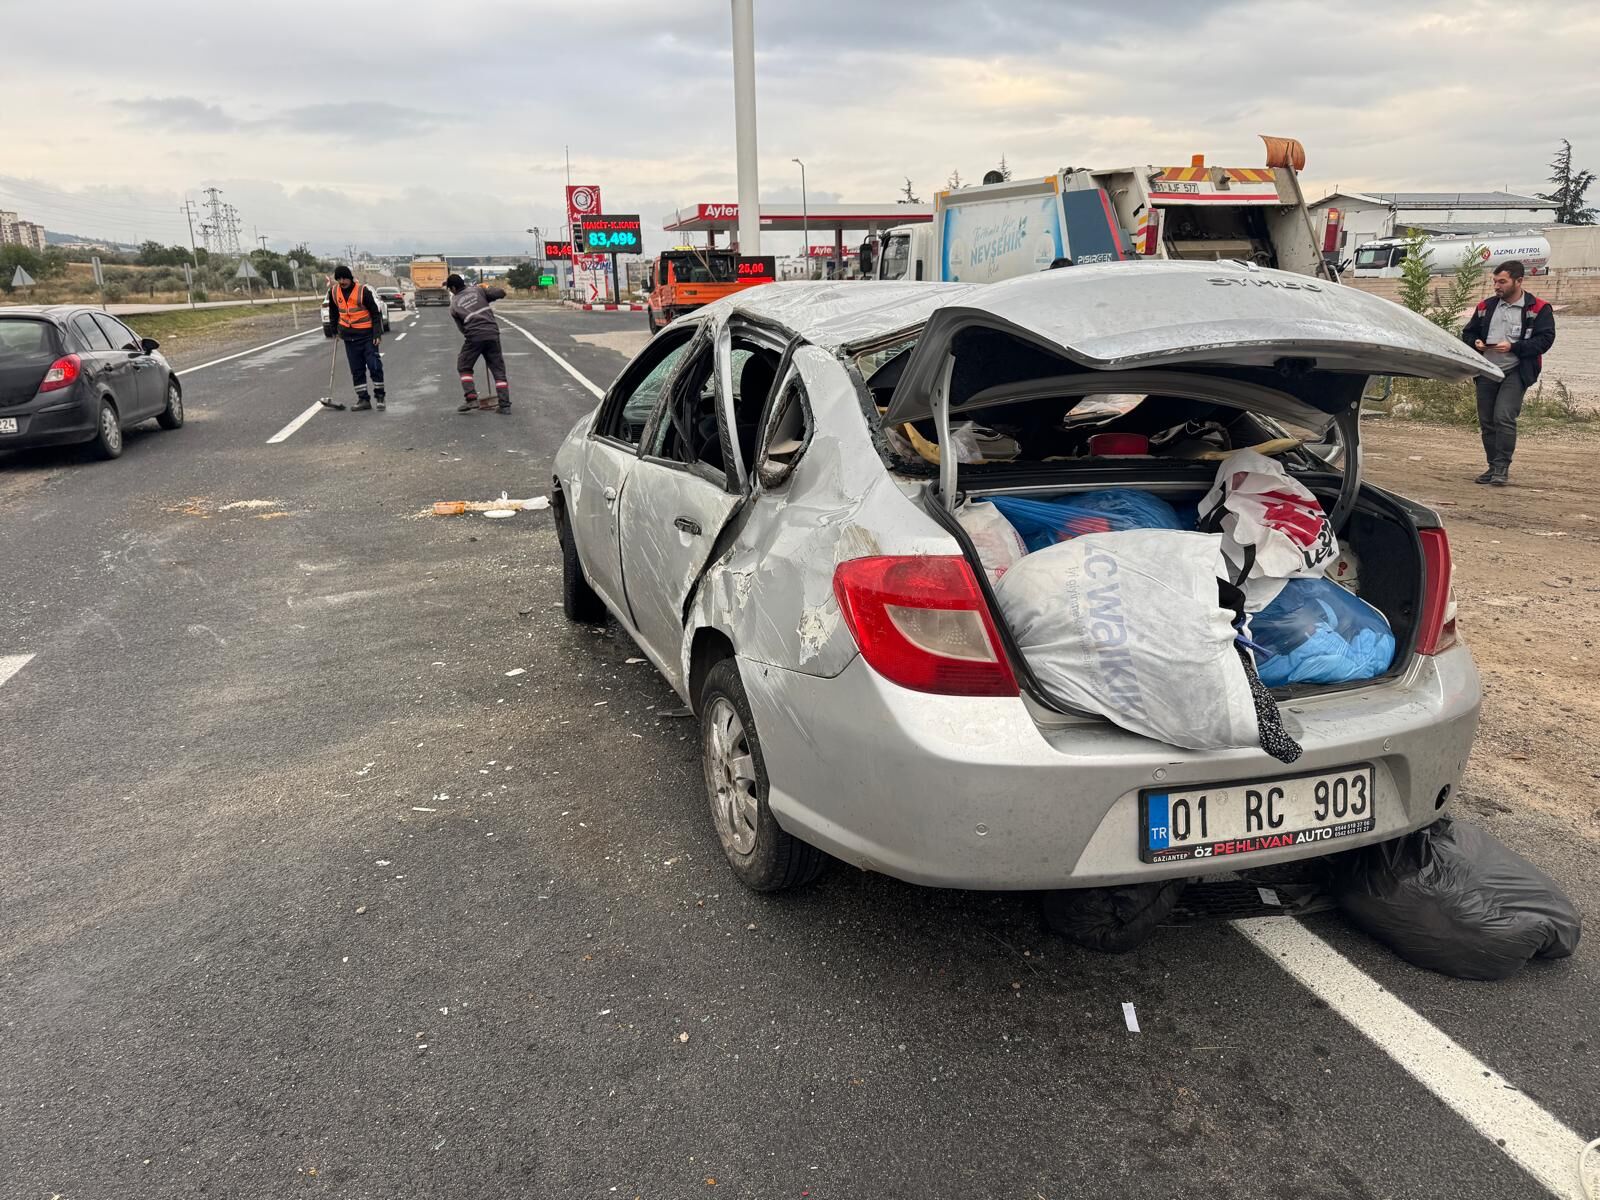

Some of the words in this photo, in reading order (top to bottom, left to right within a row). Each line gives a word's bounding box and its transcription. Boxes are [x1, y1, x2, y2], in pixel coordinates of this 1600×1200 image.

[1184, 183, 1197, 193] 577
[0, 419, 15, 430] 24
[1172, 795, 1208, 841] 01
[1246, 787, 1284, 833] RC
[1314, 774, 1368, 822] 903
[1152, 827, 1168, 840] TR
[1194, 845, 1213, 858] ÖZ
[1296, 828, 1332, 844] AUTO
